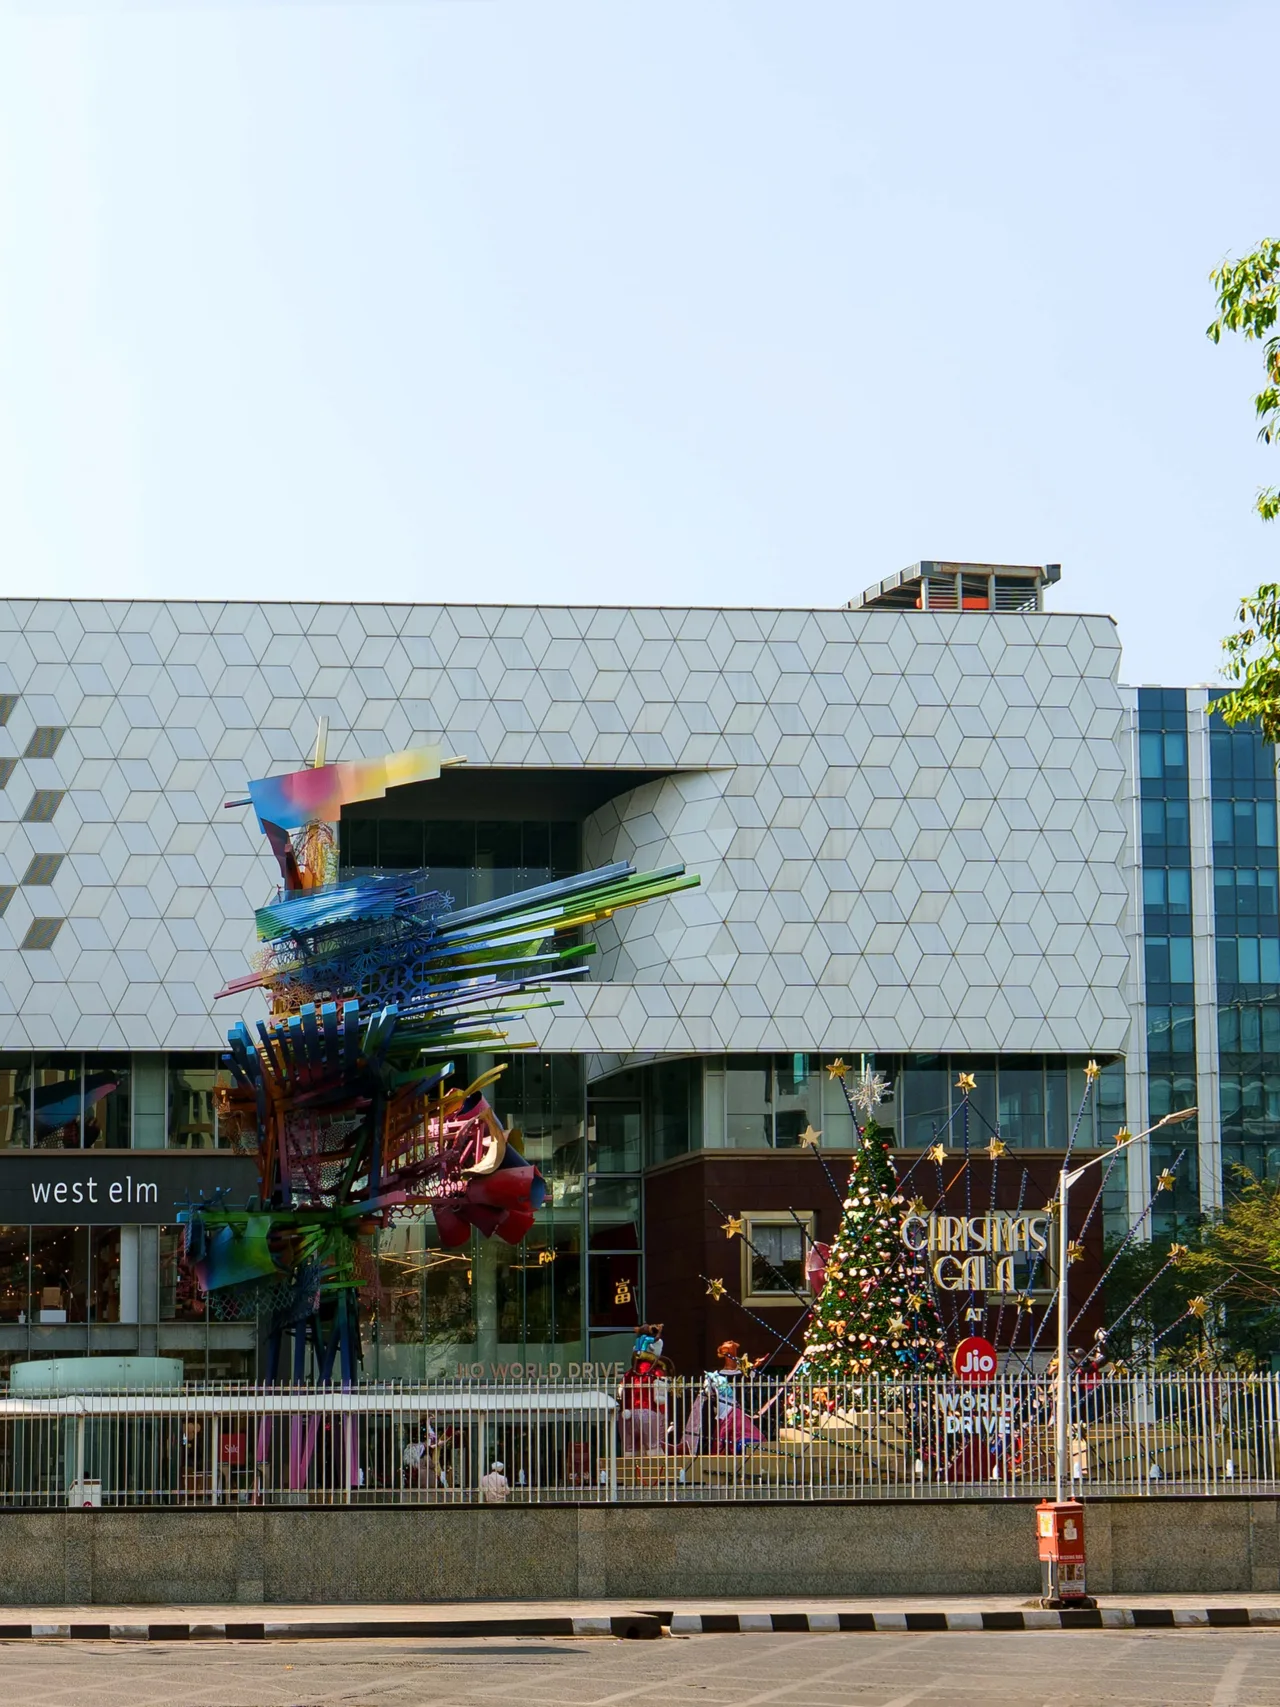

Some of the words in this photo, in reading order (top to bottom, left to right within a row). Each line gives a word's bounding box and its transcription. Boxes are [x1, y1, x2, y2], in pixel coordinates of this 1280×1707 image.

[31, 1176, 99, 1204] west
[108, 1175, 159, 1204] elm
[899, 1216, 1048, 1252] CHRISTMAS
[933, 1255, 1016, 1291] GALA
[964, 1307, 985, 1322] AT
[455, 1362, 485, 1379] JIO
[490, 1362, 562, 1379] WORLD
[568, 1362, 626, 1379] DRIVE
[960, 1349, 994, 1373] Jio
[937, 1393, 1017, 1412] WORLD
[946, 1415, 1012, 1434] DRIVE
